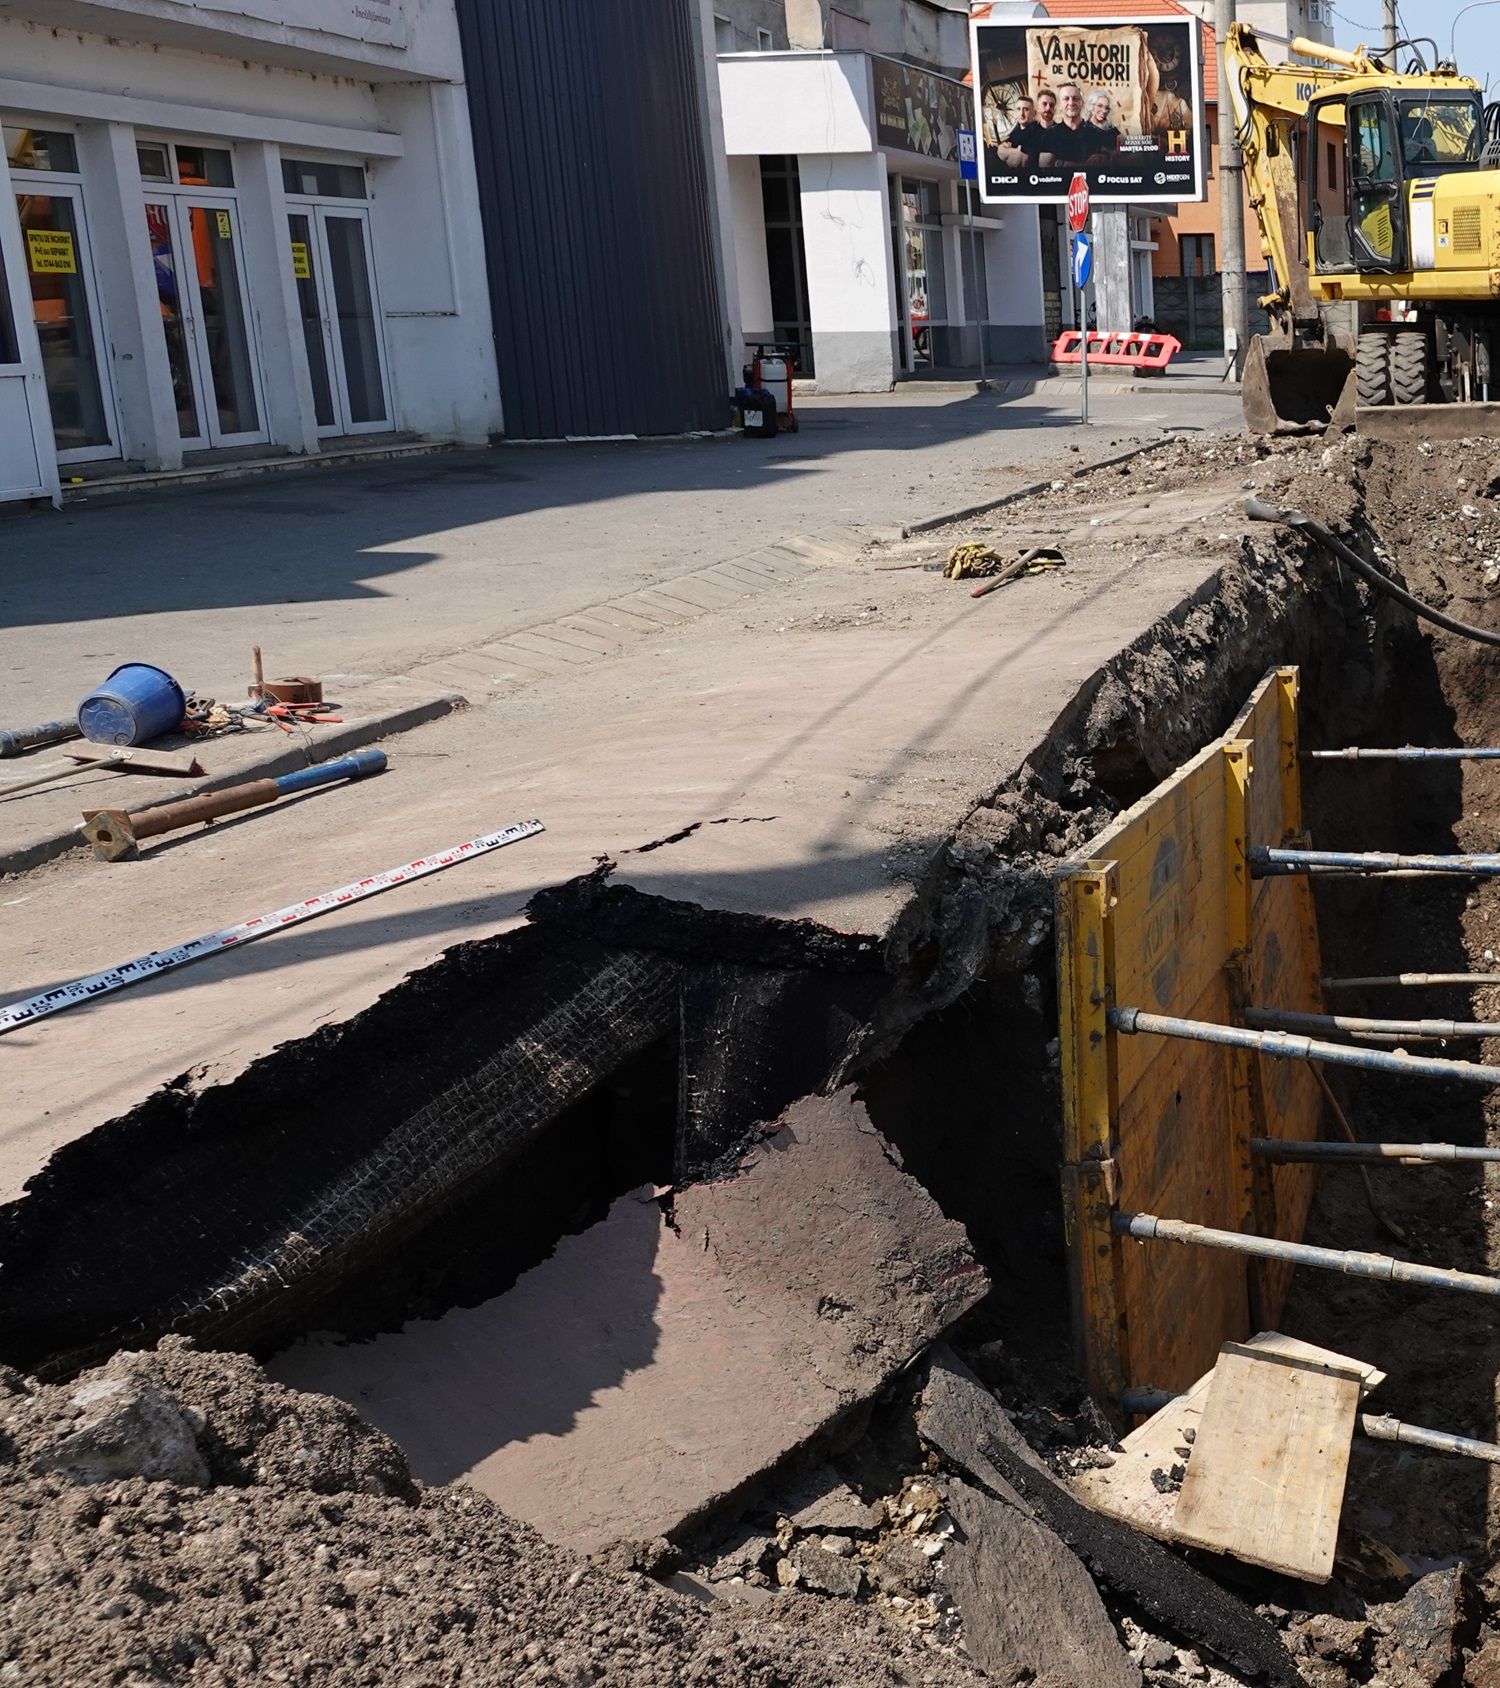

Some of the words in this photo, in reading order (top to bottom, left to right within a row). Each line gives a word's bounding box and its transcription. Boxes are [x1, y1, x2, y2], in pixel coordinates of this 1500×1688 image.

[1036, 35, 1130, 65] VÂNĂTORII
[1052, 65, 1063, 74] DE
[1067, 62, 1130, 81] COMORI
[1167, 130, 1189, 154] H
[991, 176, 1018, 184] DIGI
[1069, 190, 1087, 217] STOP
